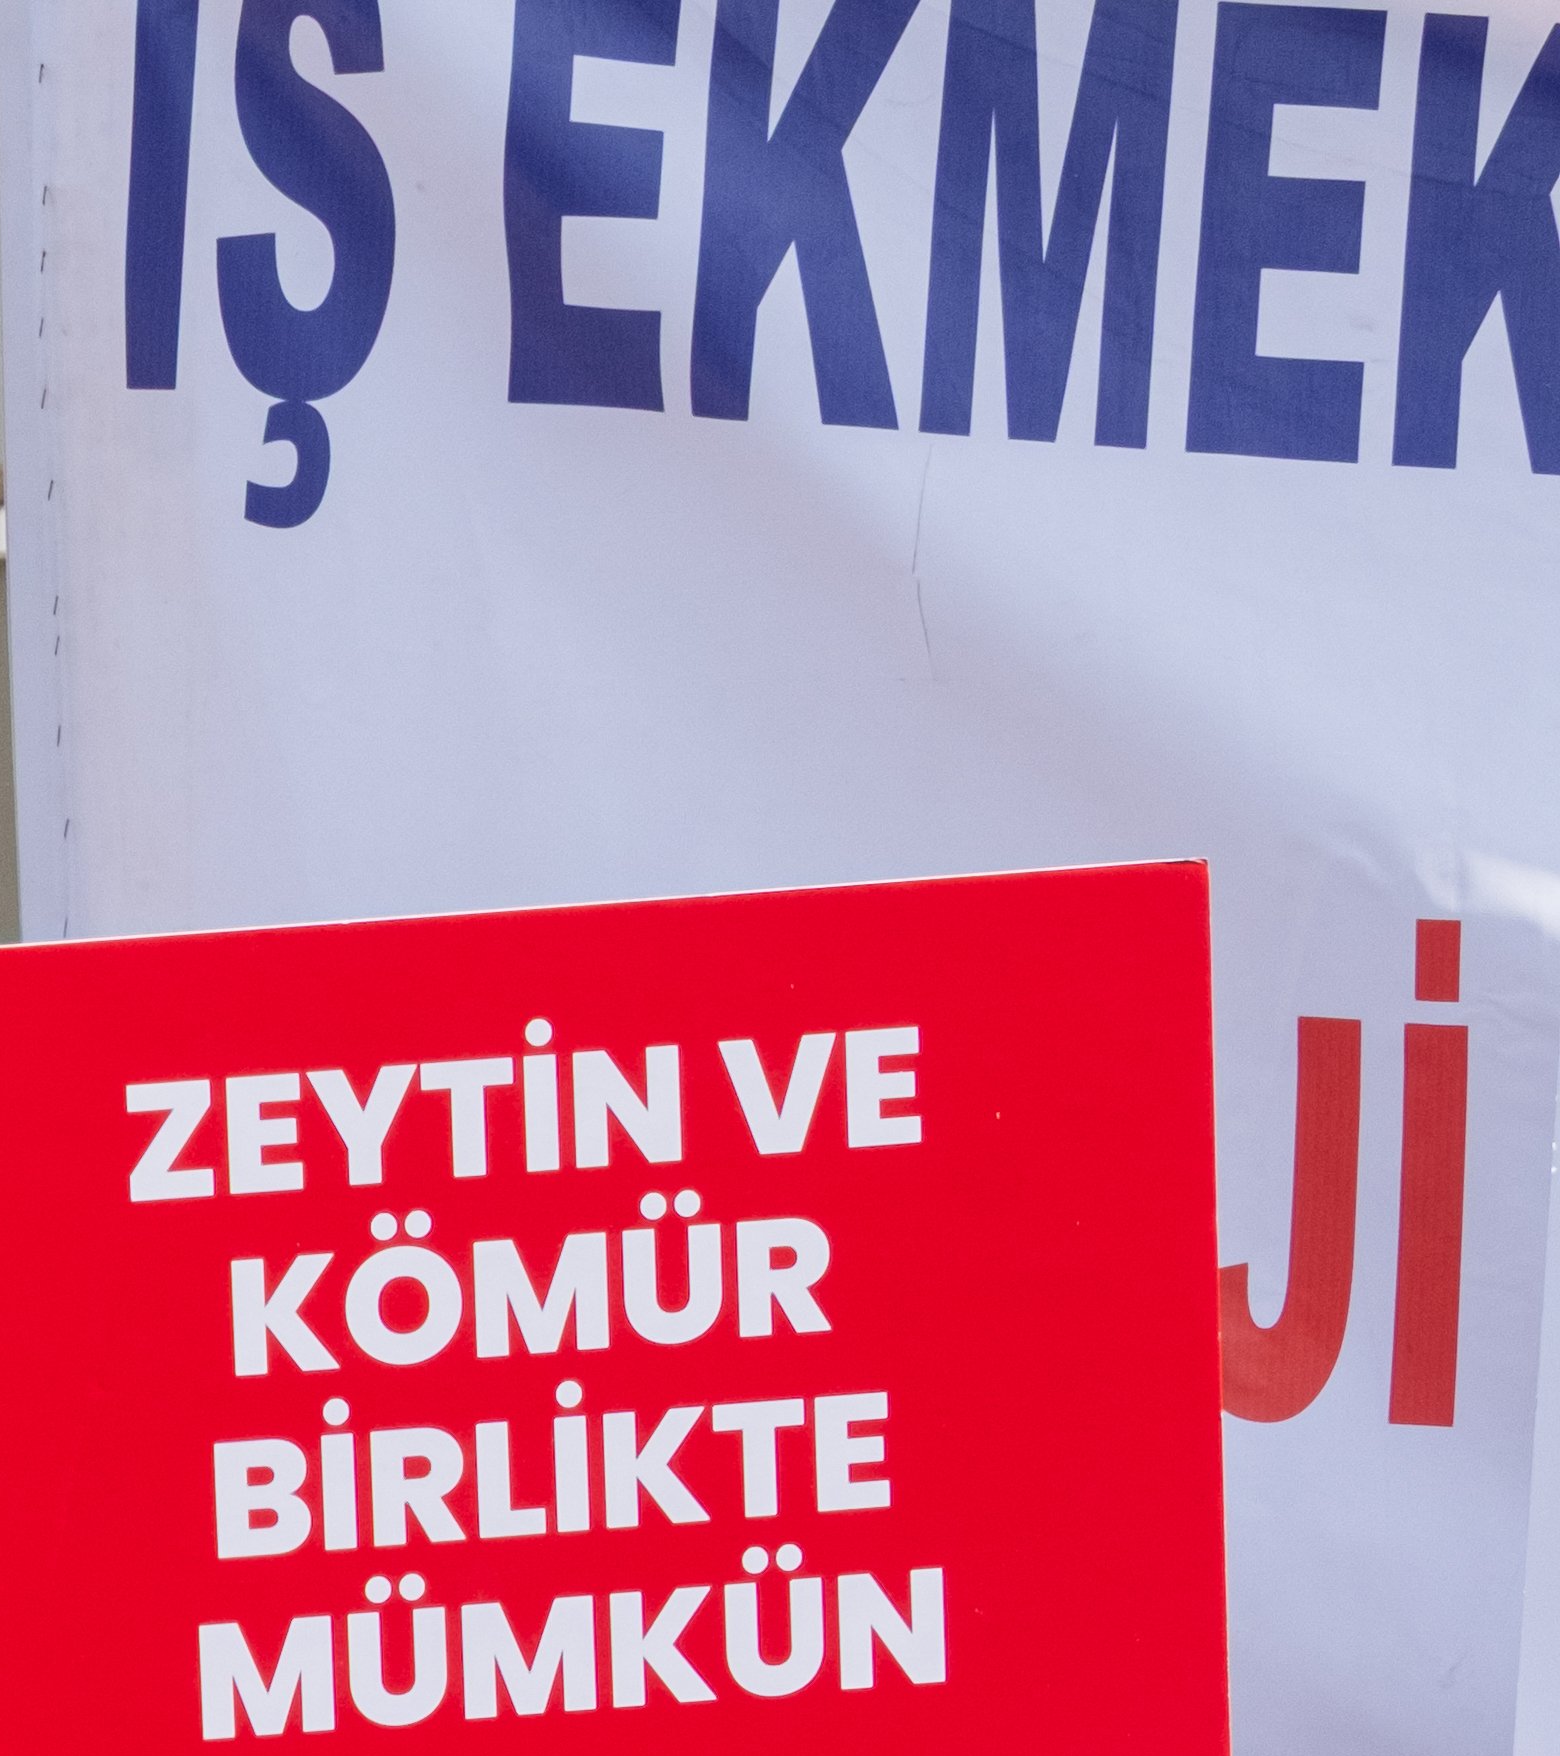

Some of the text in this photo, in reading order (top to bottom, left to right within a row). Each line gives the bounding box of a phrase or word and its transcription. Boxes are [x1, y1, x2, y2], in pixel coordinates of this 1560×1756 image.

[504, 0, 1560, 476] EKMEK
[125, 1018, 922, 1203] ZEYTİN VE
[230, 1189, 832, 1377] KÖMÜR
[213, 1380, 891, 1562] BİRLİKTE
[198, 1543, 946, 1741] MÜMKÜN
